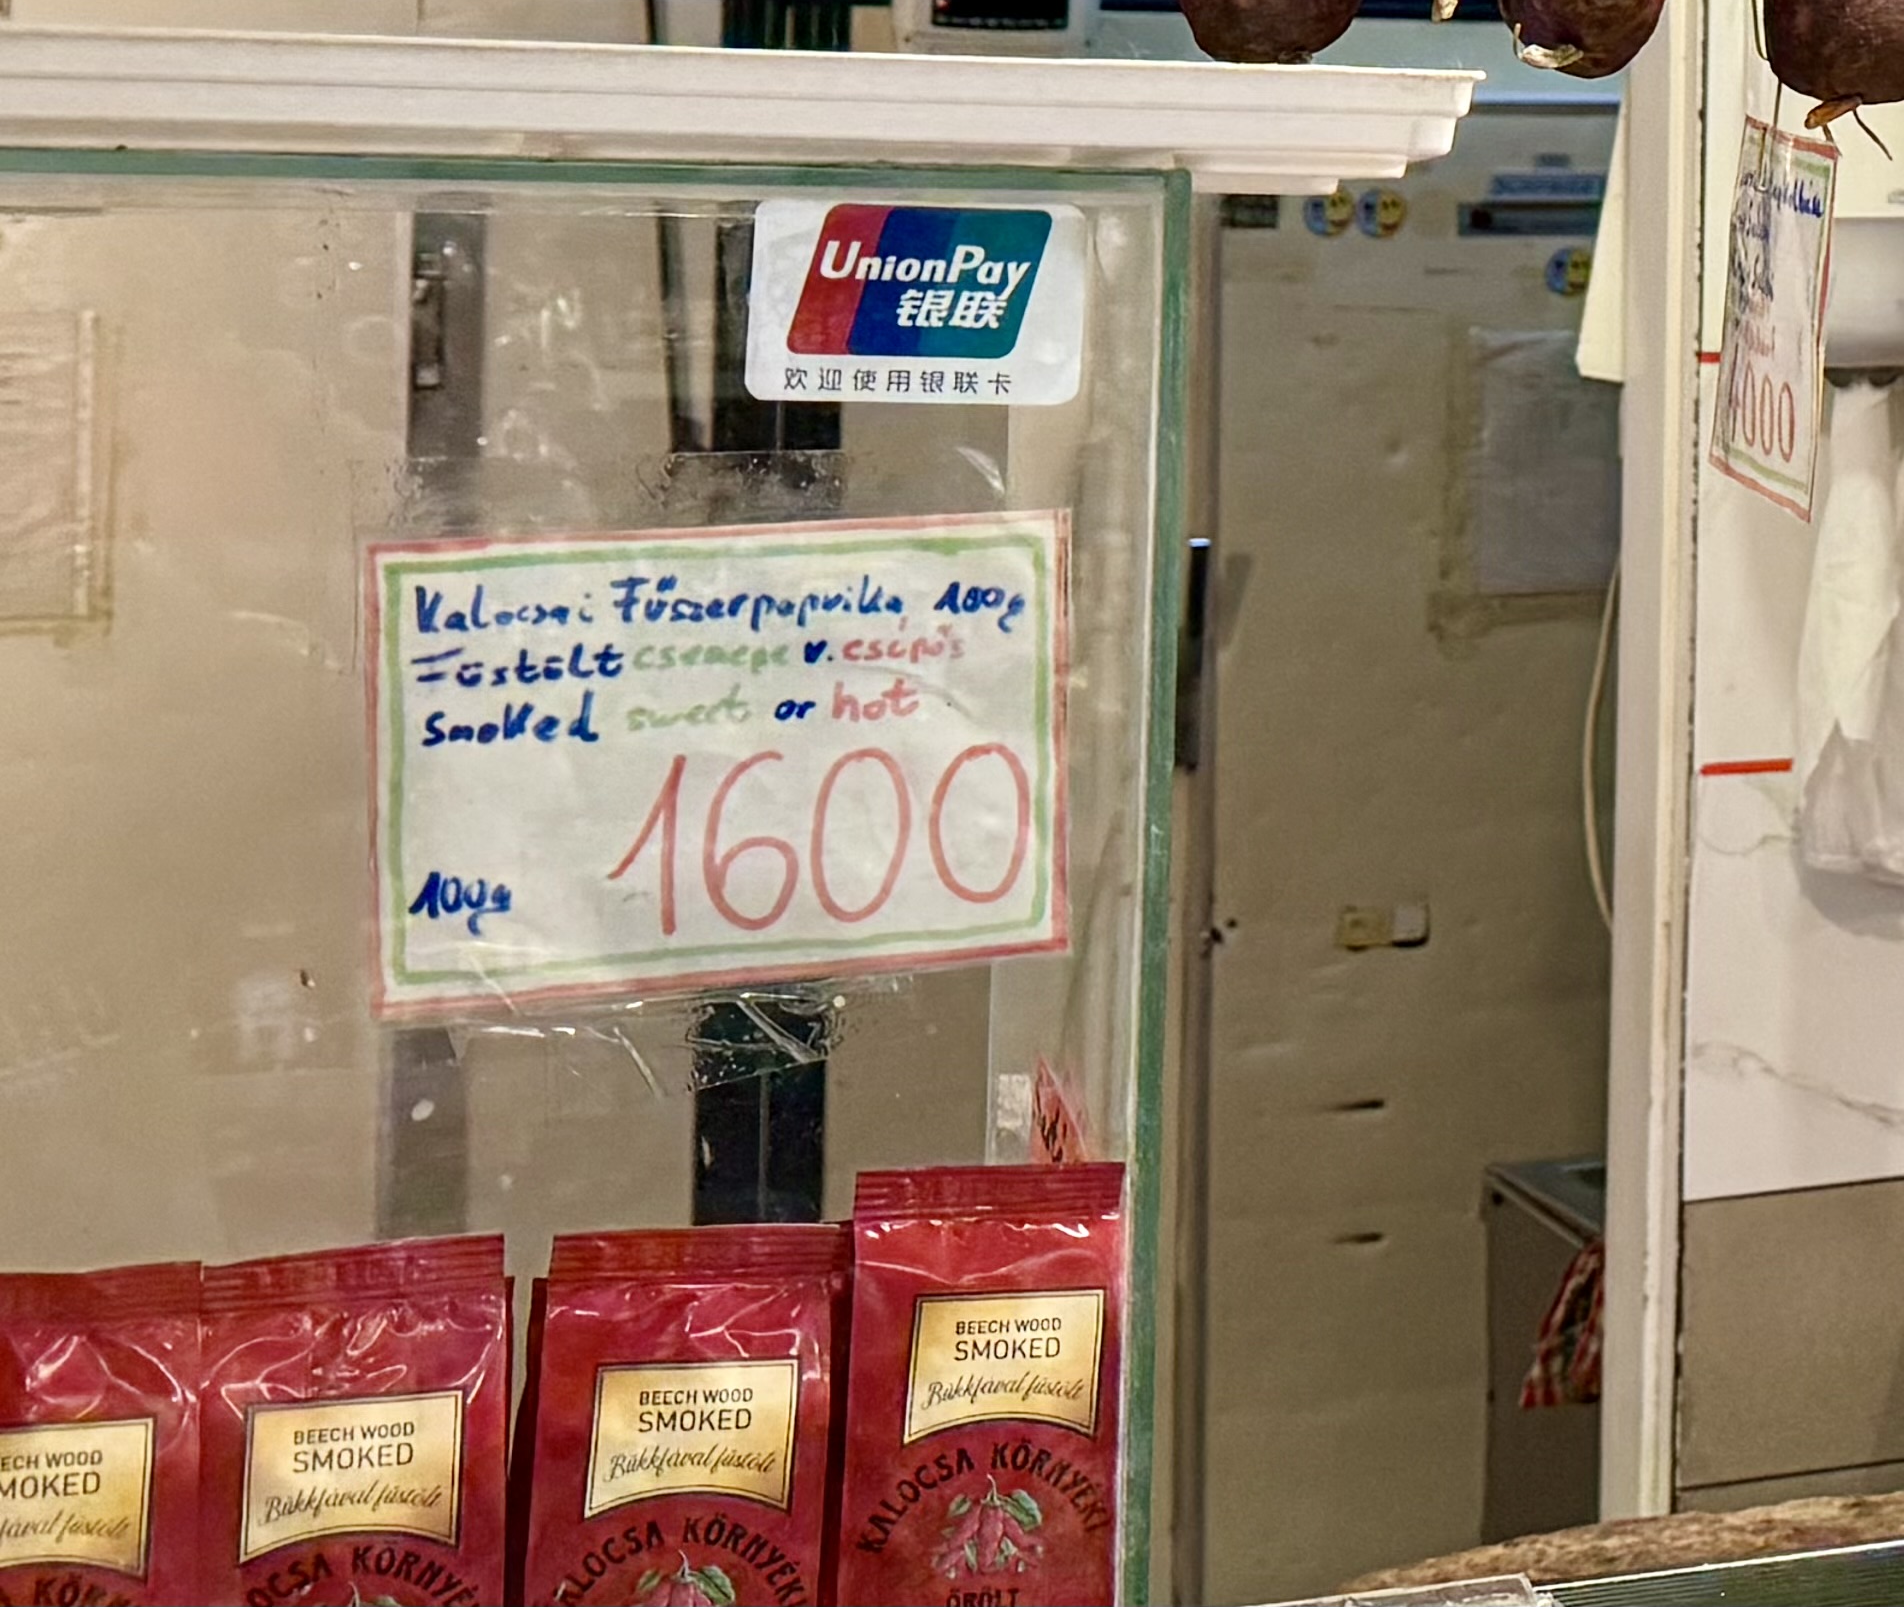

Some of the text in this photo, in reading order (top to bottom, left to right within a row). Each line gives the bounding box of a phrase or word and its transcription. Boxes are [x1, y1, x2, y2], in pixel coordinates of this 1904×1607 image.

[819, 239, 1032, 300] UnionPay
[895, 288, 1008, 330] 银联
[783, 367, 1014, 396] 欢迎使用银联卡
[421, 690, 600, 749] Smoked
[774, 697, 818, 723] or
[831, 677, 921, 723] hot
[605, 742, 1031, 936] 1600
[954, 1317, 1062, 1337] BEECH WOOD
[953, 1336, 1061, 1362] SMOKED
[638, 1387, 754, 1408] BEECH WOOD
[292, 1420, 416, 1446] BEECH WOOD
[637, 1407, 753, 1433] SMOKED
[45, 1449, 104, 1469] WOOD
[292, 1441, 415, 1473] SMOKED
[856, 1443, 1110, 1556] KALOCSA KÖRNYÉKI
